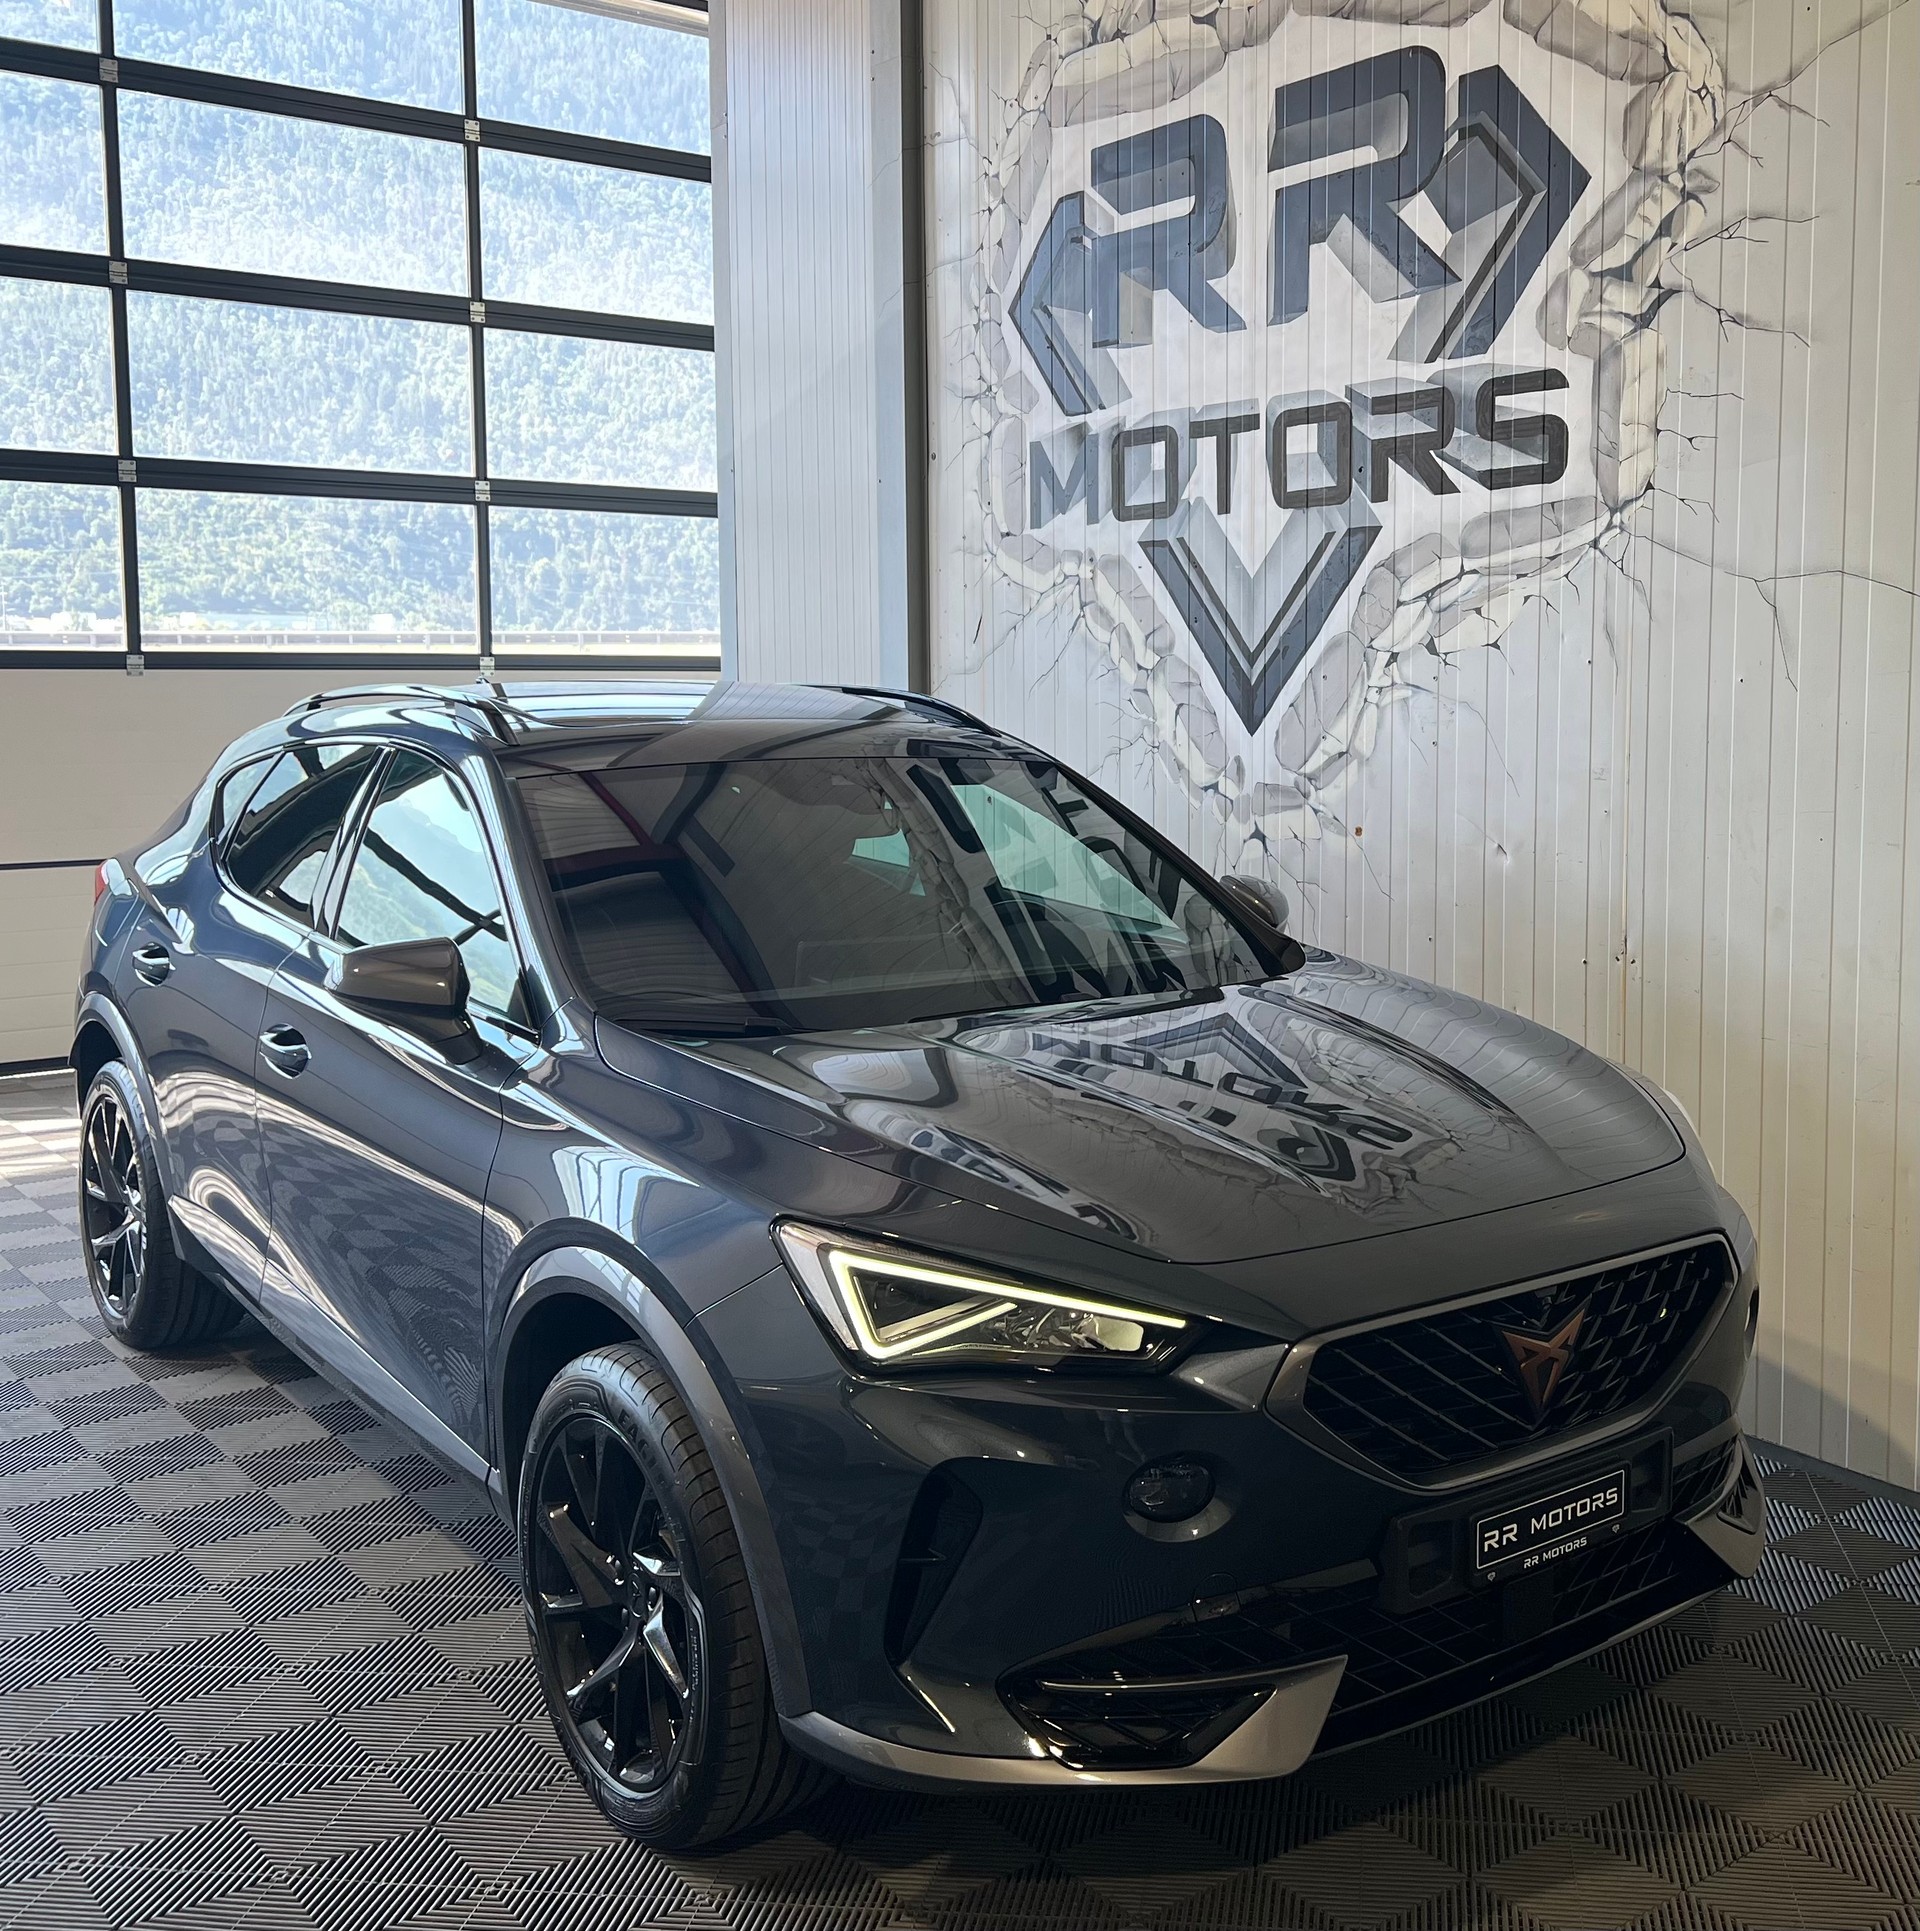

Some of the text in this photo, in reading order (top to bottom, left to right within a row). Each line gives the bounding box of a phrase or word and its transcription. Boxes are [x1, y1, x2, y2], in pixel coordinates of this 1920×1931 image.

[1090, 45, 1462, 349] RR
[1029, 366, 1571, 530] MOTORS
[1484, 1488, 1617, 1552] RR MOTORS
[1524, 1537, 1587, 1568] RR MOTORS
